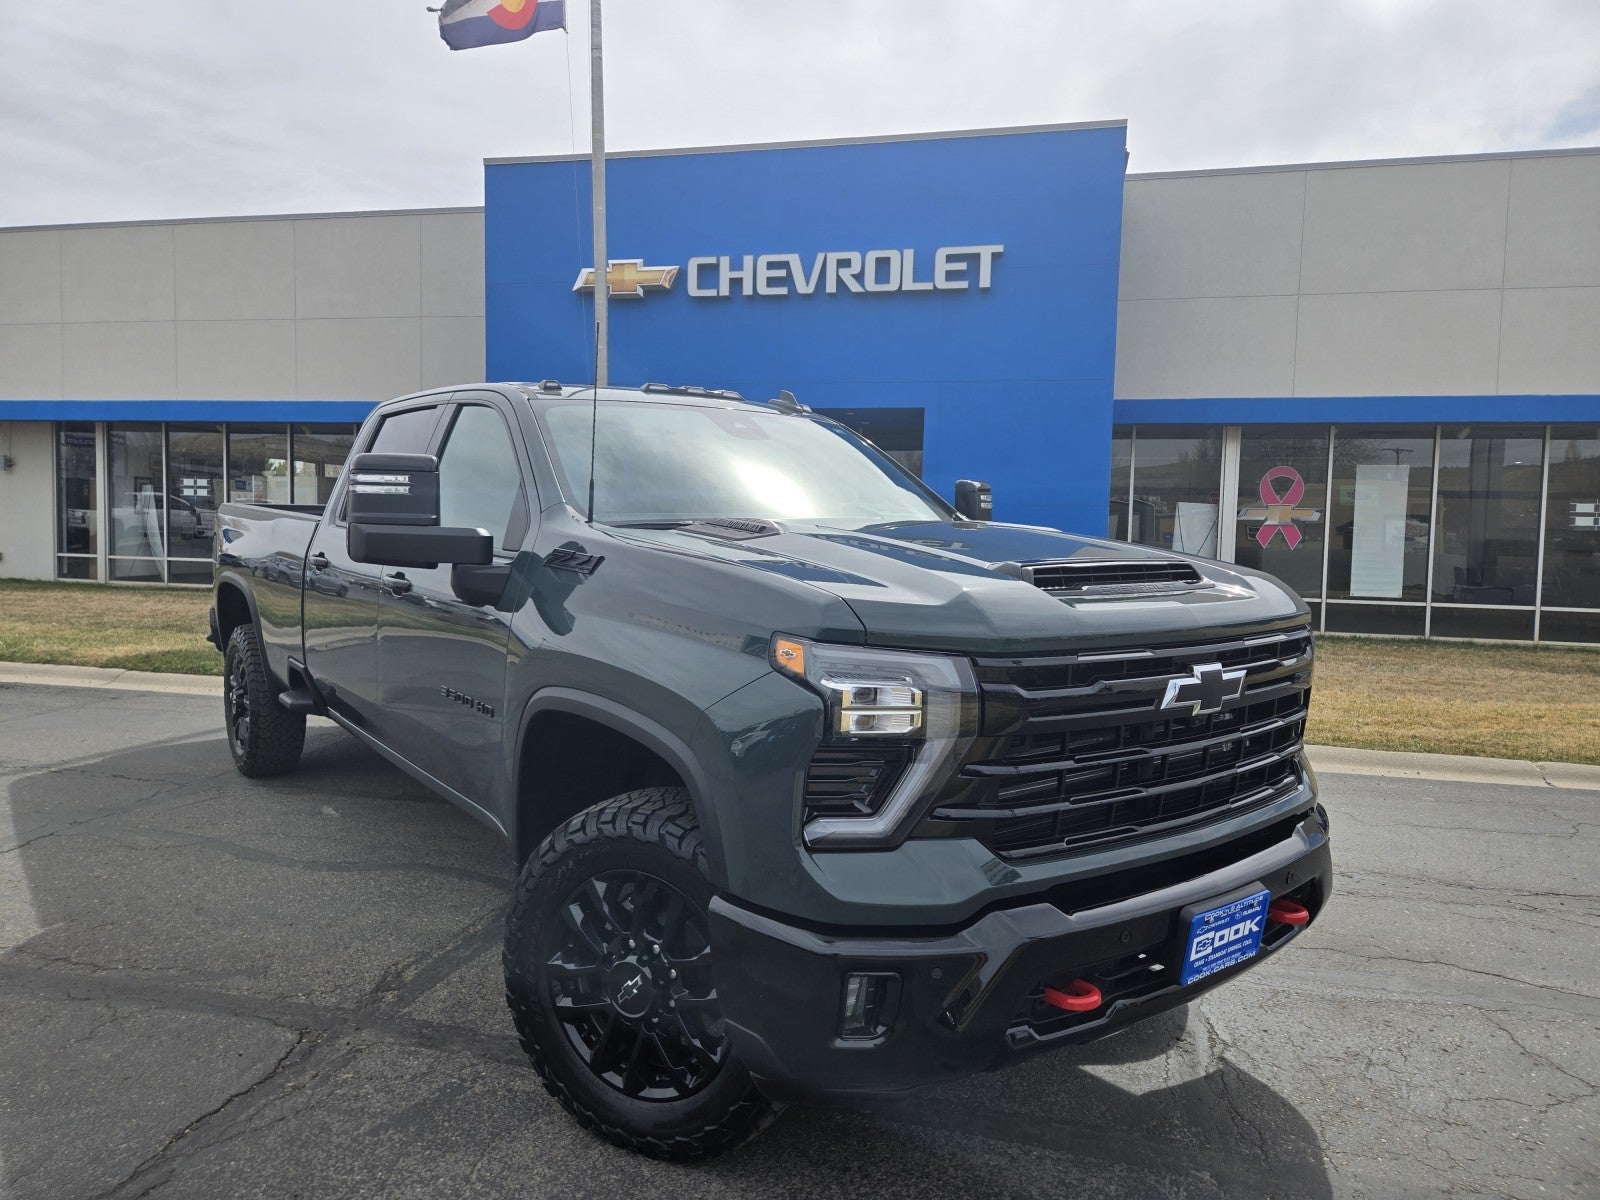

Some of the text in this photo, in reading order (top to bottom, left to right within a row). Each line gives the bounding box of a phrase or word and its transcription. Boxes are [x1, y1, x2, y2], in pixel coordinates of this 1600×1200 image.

[687, 245, 1004, 297] CHEVROLET
[1101, 583, 1176, 594] CHEVROLET
[1190, 916, 1262, 961] COOK
